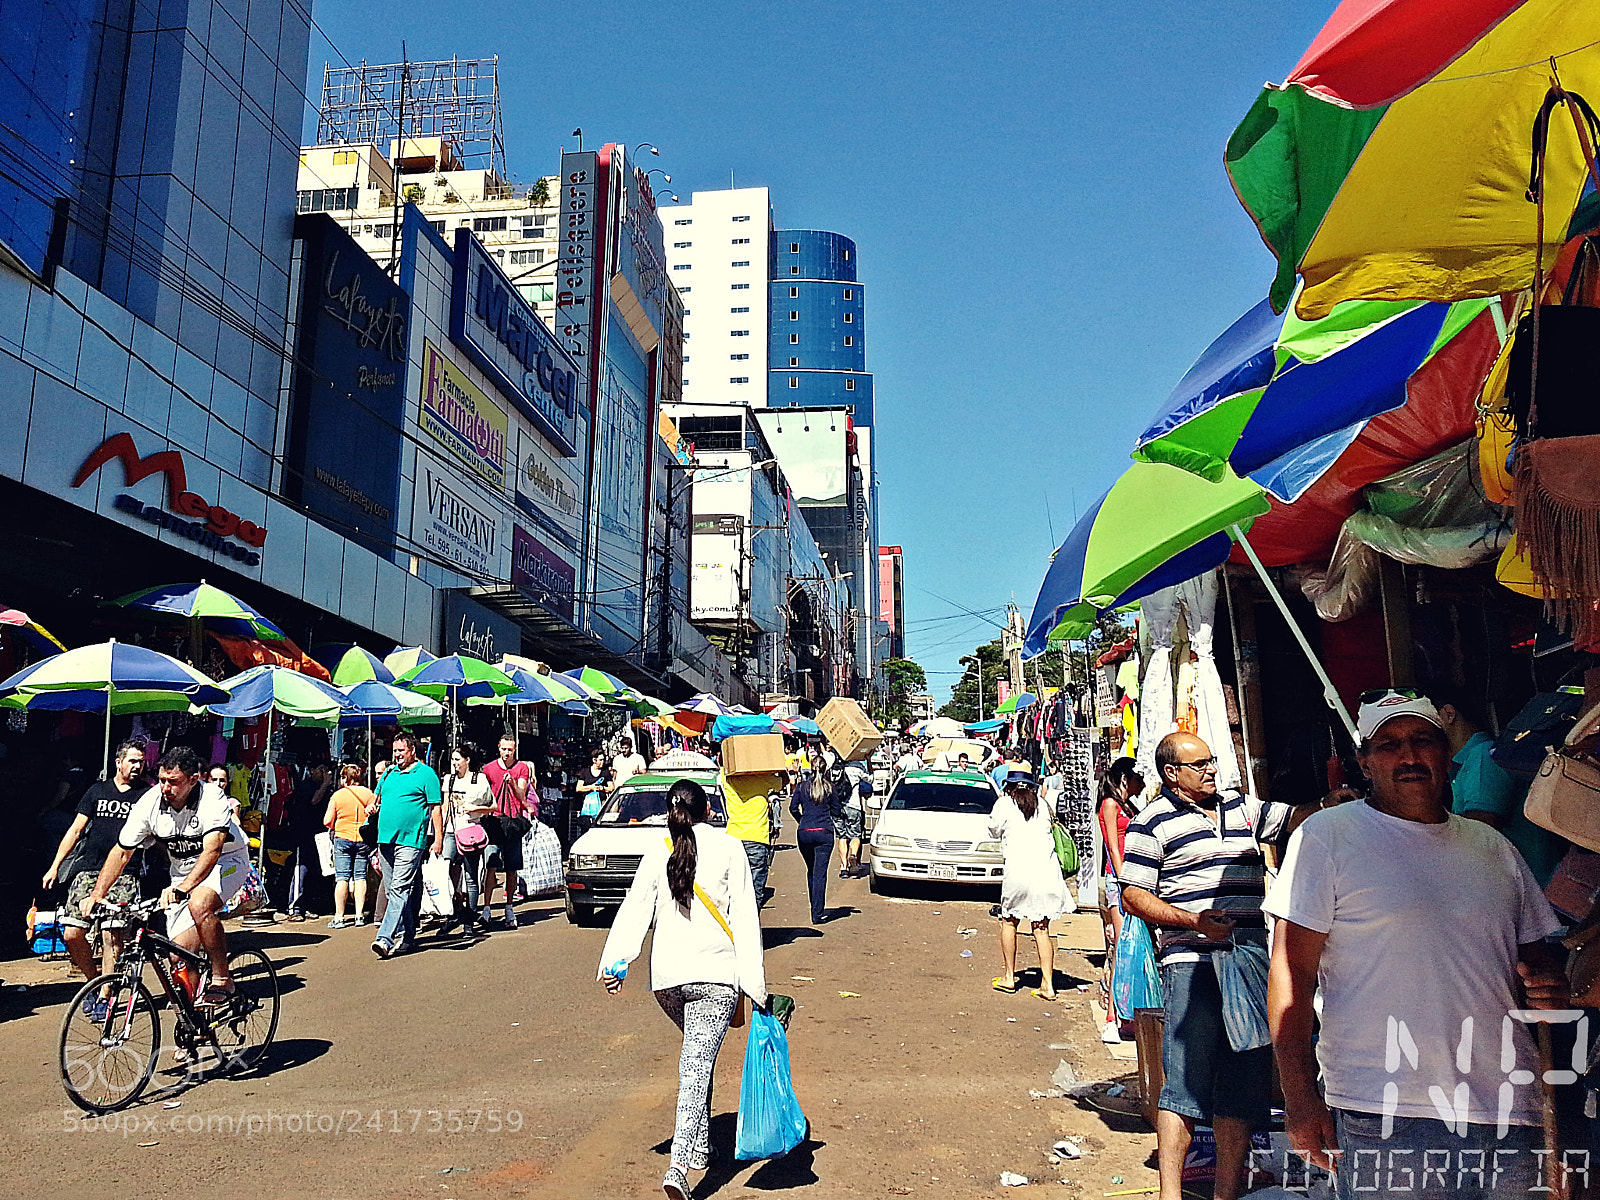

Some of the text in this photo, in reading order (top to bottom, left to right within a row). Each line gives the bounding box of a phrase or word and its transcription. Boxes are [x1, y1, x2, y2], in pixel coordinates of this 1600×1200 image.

[558, 169, 590, 310] Petisquera
[476, 263, 576, 420] Marcel
[443, 369, 476, 415] Farmacia
[70, 432, 268, 547] Mega
[437, 540, 450, 555] 595
[97, 800, 133, 814] BOS
